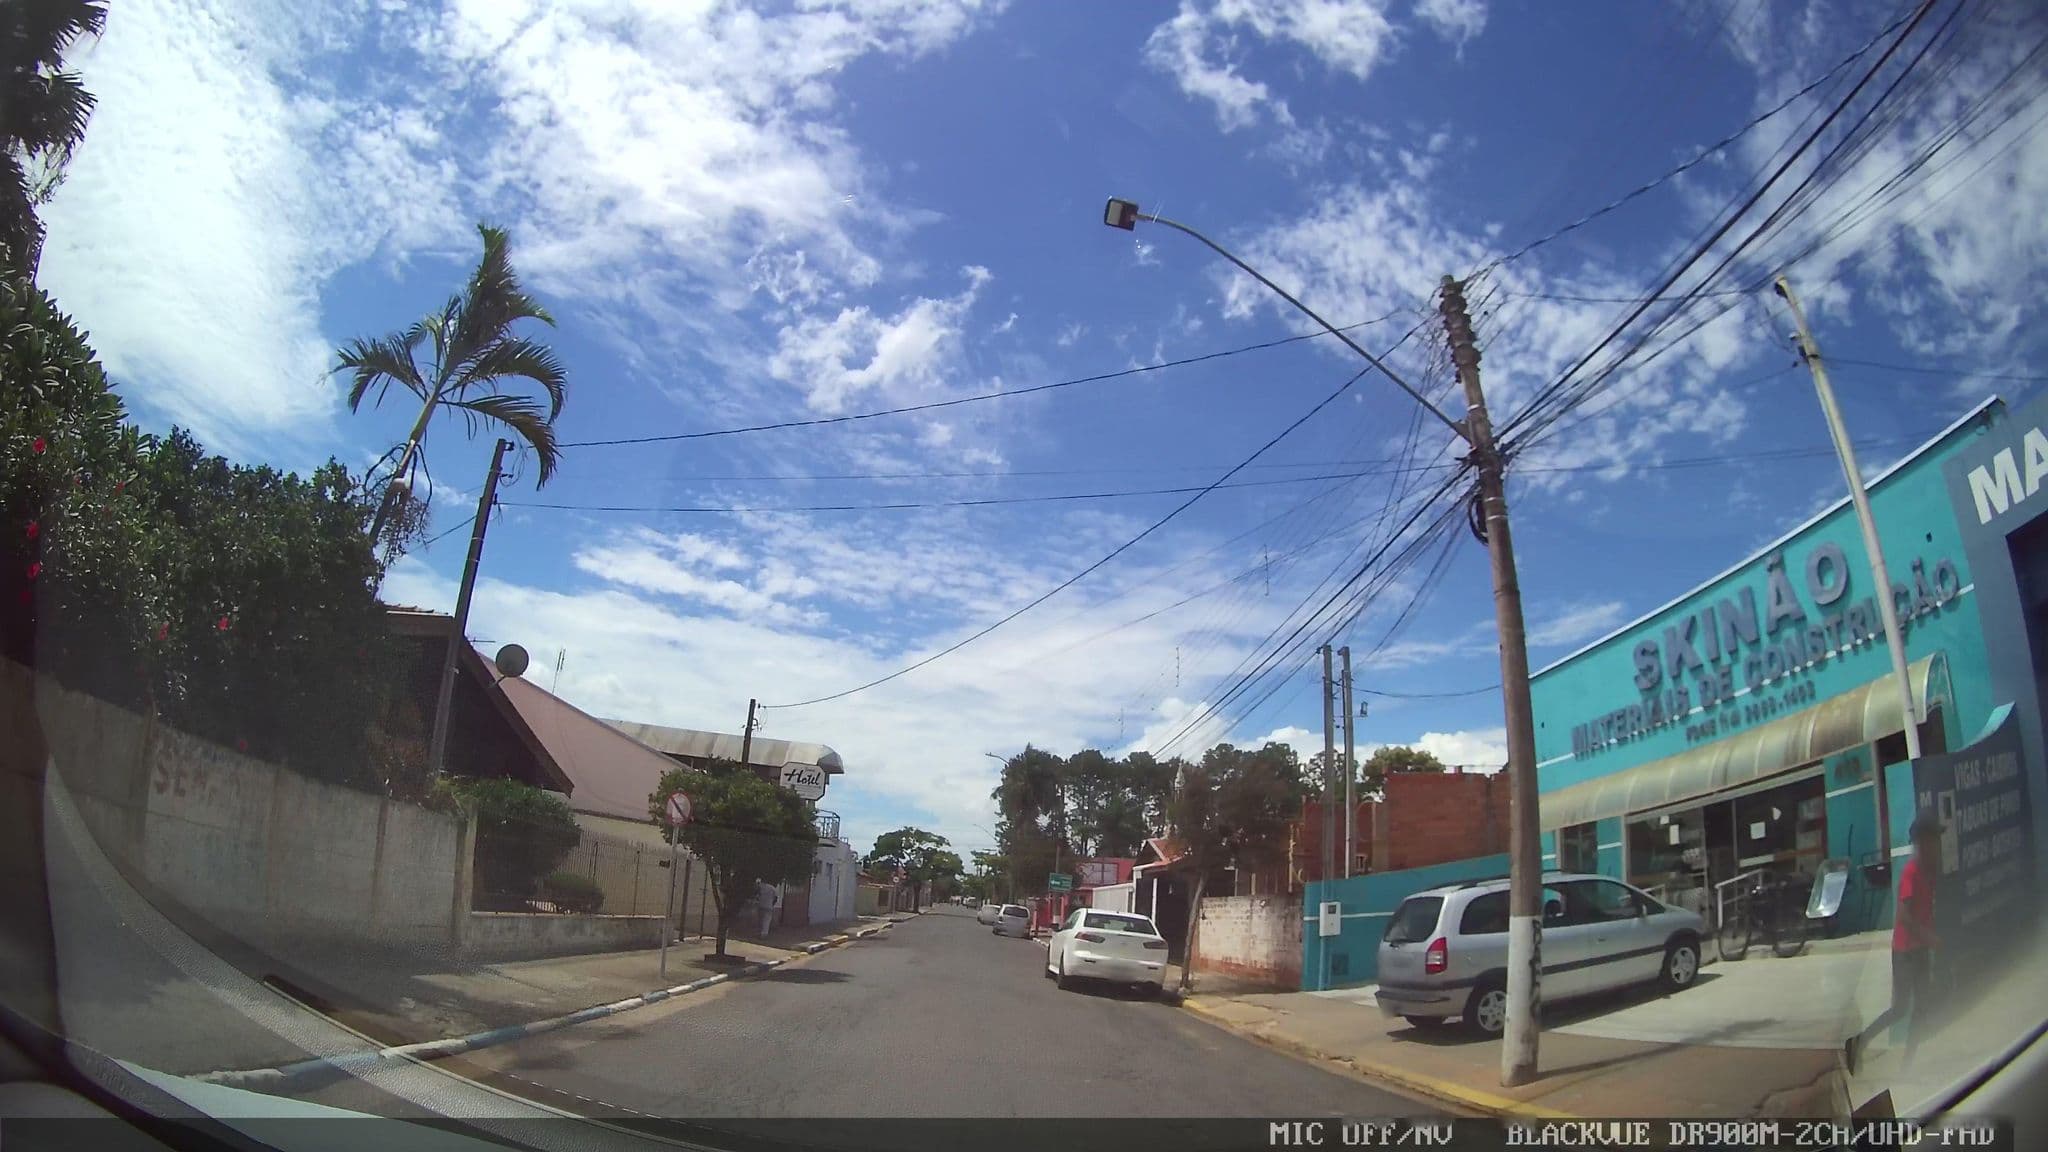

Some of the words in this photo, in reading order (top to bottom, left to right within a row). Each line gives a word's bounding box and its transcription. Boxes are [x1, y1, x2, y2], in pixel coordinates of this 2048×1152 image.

[1571, 684, 1692, 760] MATERIAIS
[1699, 662, 1737, 710] DE
[1742, 557, 1960, 695] CONSTRUÇÃO
[1633, 541, 1849, 690] SKINÃO
[784, 769, 821, 785] Hotel
